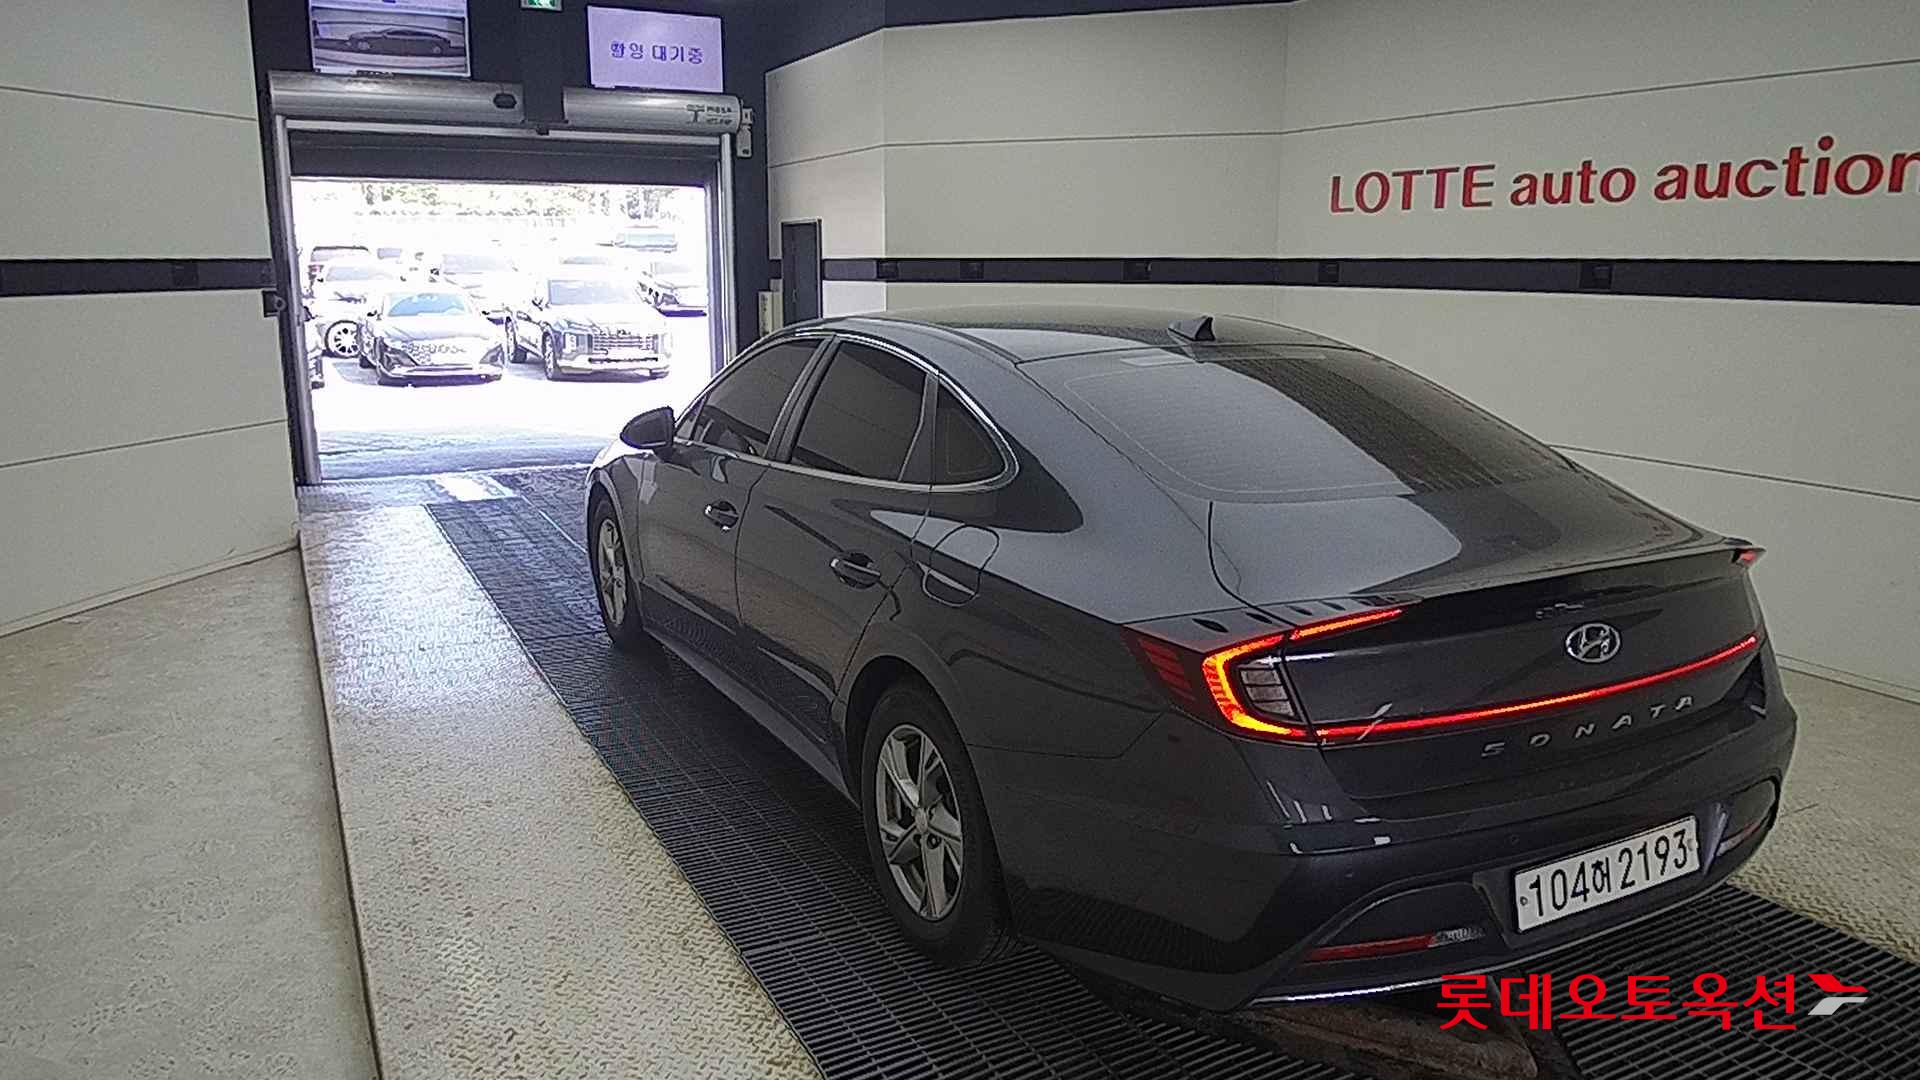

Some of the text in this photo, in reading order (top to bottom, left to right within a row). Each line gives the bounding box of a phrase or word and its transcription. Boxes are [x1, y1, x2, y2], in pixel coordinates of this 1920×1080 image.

[652, 44, 704, 65] 대기중
[1331, 165, 1496, 215] LOTTE
[1510, 160, 1638, 207] auto
[1481, 695, 1695, 758] SONATA
